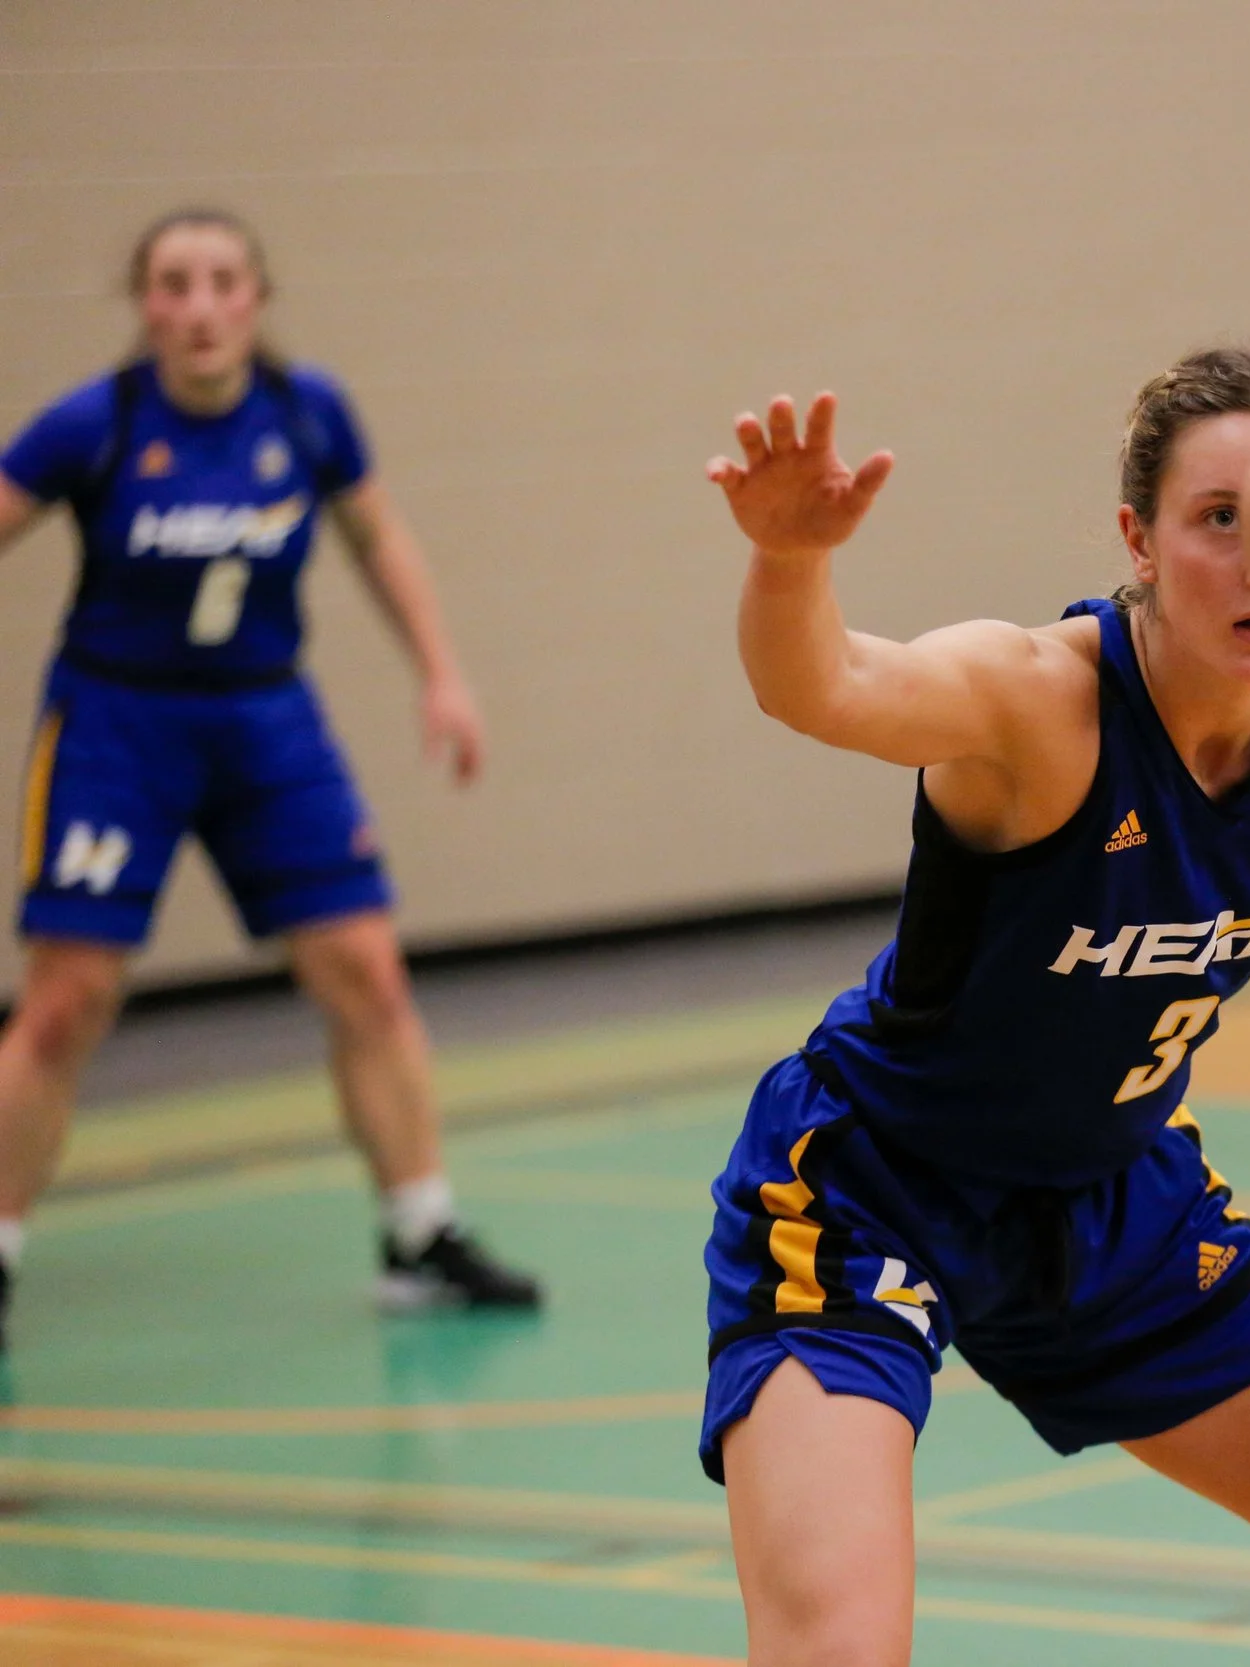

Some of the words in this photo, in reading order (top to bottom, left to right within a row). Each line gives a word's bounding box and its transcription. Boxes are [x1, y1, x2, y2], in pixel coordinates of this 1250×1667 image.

[1104, 832, 1148, 853] adidas
[1113, 995, 1220, 1104] 3
[1199, 1244, 1238, 1291] adidas
